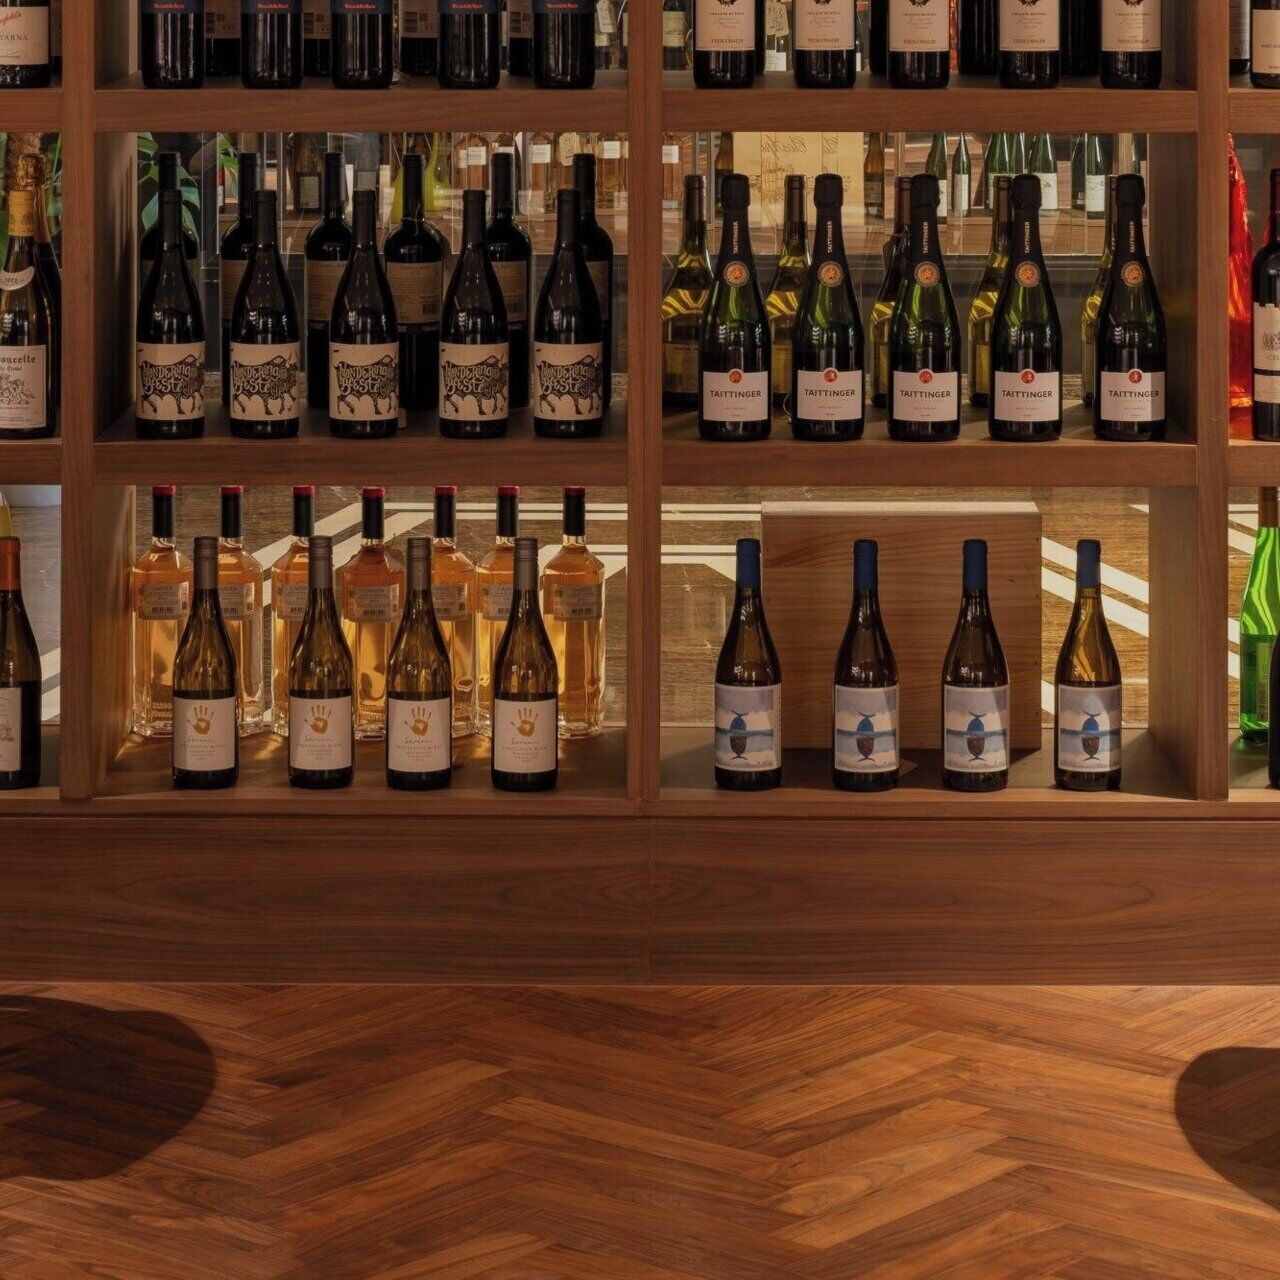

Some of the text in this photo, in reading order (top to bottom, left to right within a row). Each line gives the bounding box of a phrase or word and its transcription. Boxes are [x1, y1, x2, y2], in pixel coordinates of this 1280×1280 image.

[710, 390, 761, 398] TAITTINGER
[804, 389, 855, 397] TAITTINGER
[1002, 390, 1052, 398] TAITTINGER
